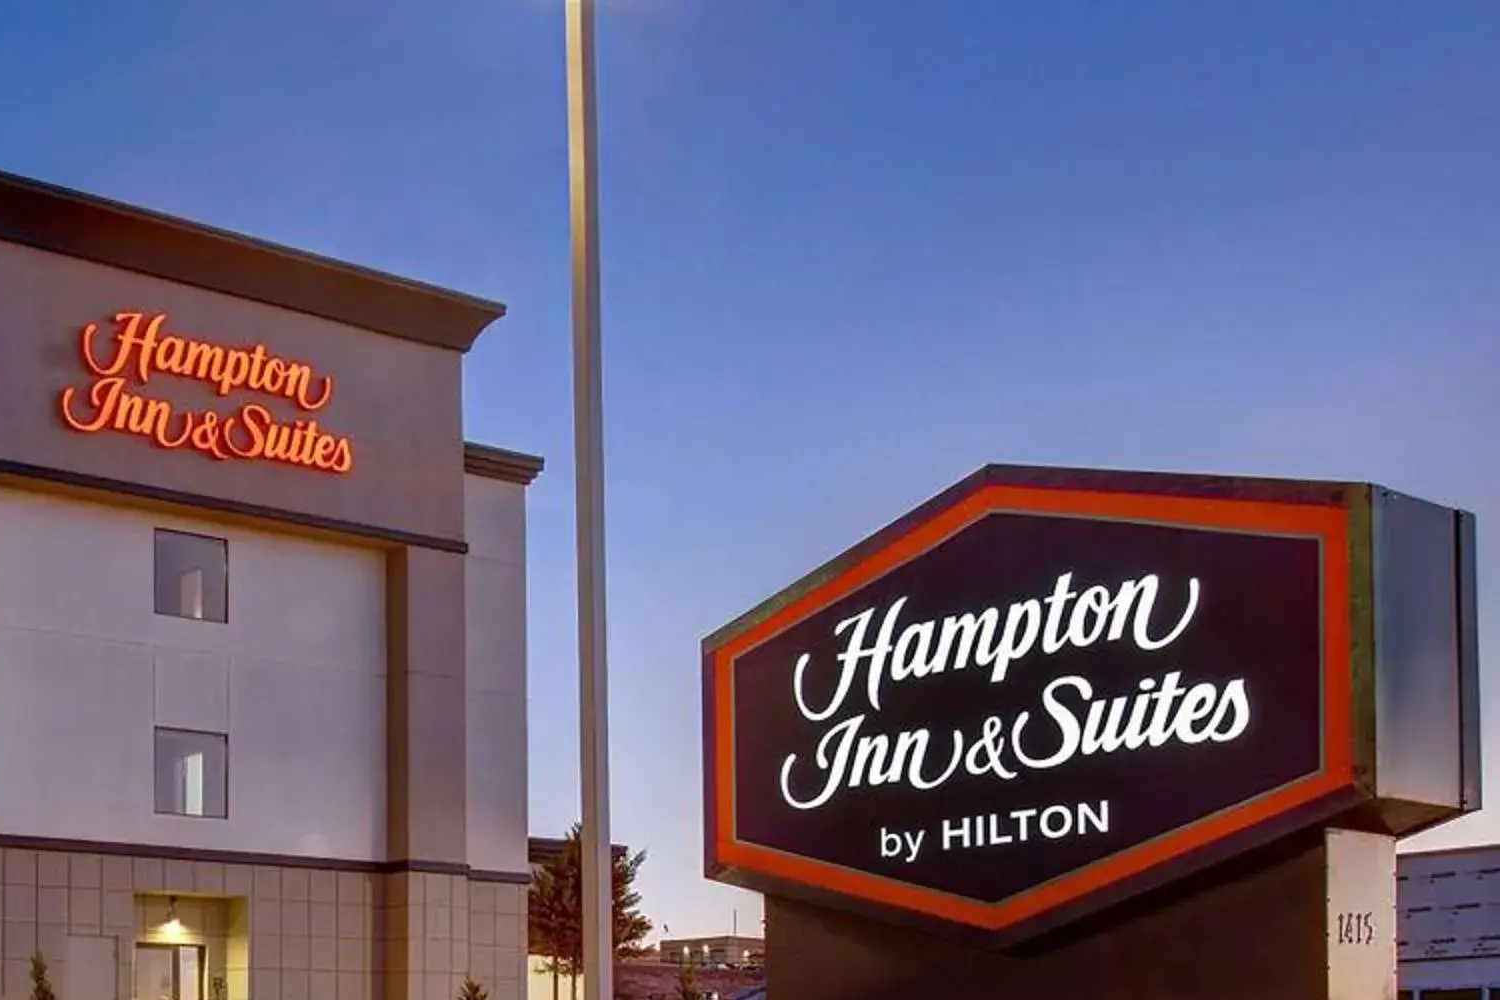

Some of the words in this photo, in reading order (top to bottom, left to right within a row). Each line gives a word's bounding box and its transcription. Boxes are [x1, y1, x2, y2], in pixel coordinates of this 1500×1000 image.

[82, 311, 333, 411] Hampton
[62, 376, 193, 448] Inn
[191, 410, 229, 460] &
[223, 404, 353, 474] Suites
[792, 570, 1201, 722] Hampton
[779, 714, 964, 811] Inn
[964, 714, 1019, 781] &
[1011, 670, 1251, 770] Suites
[880, 826, 926, 864] by
[941, 799, 1110, 851] HILTON
